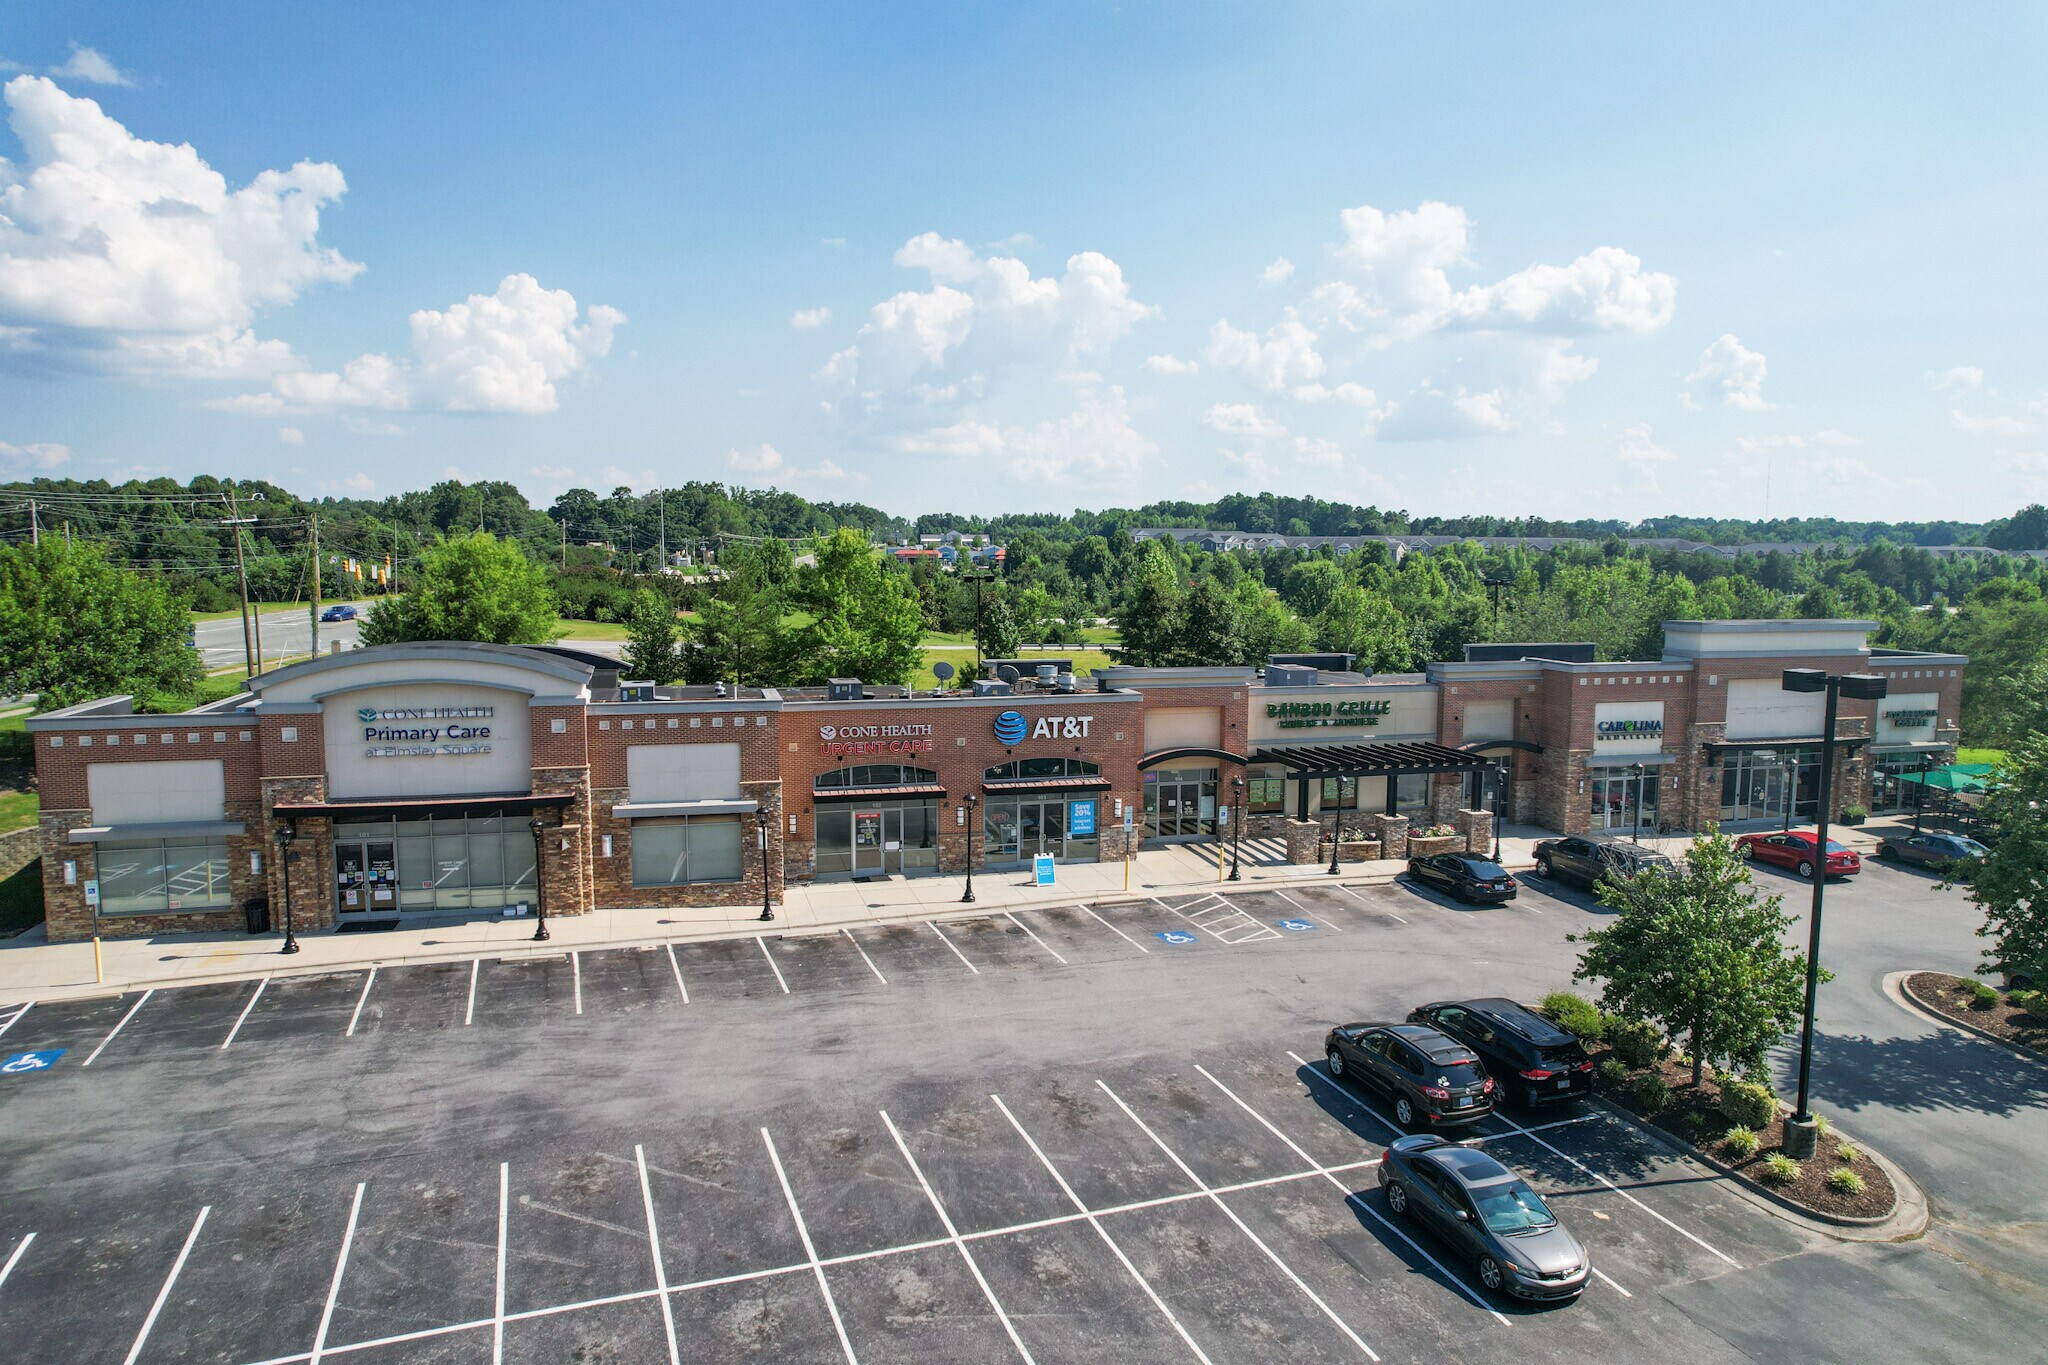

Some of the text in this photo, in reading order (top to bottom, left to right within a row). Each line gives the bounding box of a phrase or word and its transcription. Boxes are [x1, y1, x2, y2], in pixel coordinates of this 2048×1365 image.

[382, 706, 494, 720] CONE HEALTH
[1266, 700, 1391, 718] BAMBOO GRILLE
[365, 725, 491, 742] Primary Care
[839, 724, 933, 738] CONE HEALTH
[1032, 715, 1094, 739] AT&T
[1598, 720, 1662, 732] CAROLINA
[1597, 733, 1662, 741] DENTISTRY
[366, 743, 492, 759] at Elmsley Square
[821, 739, 933, 756] URGENT CARE
[1074, 809, 1091, 817] 20%
